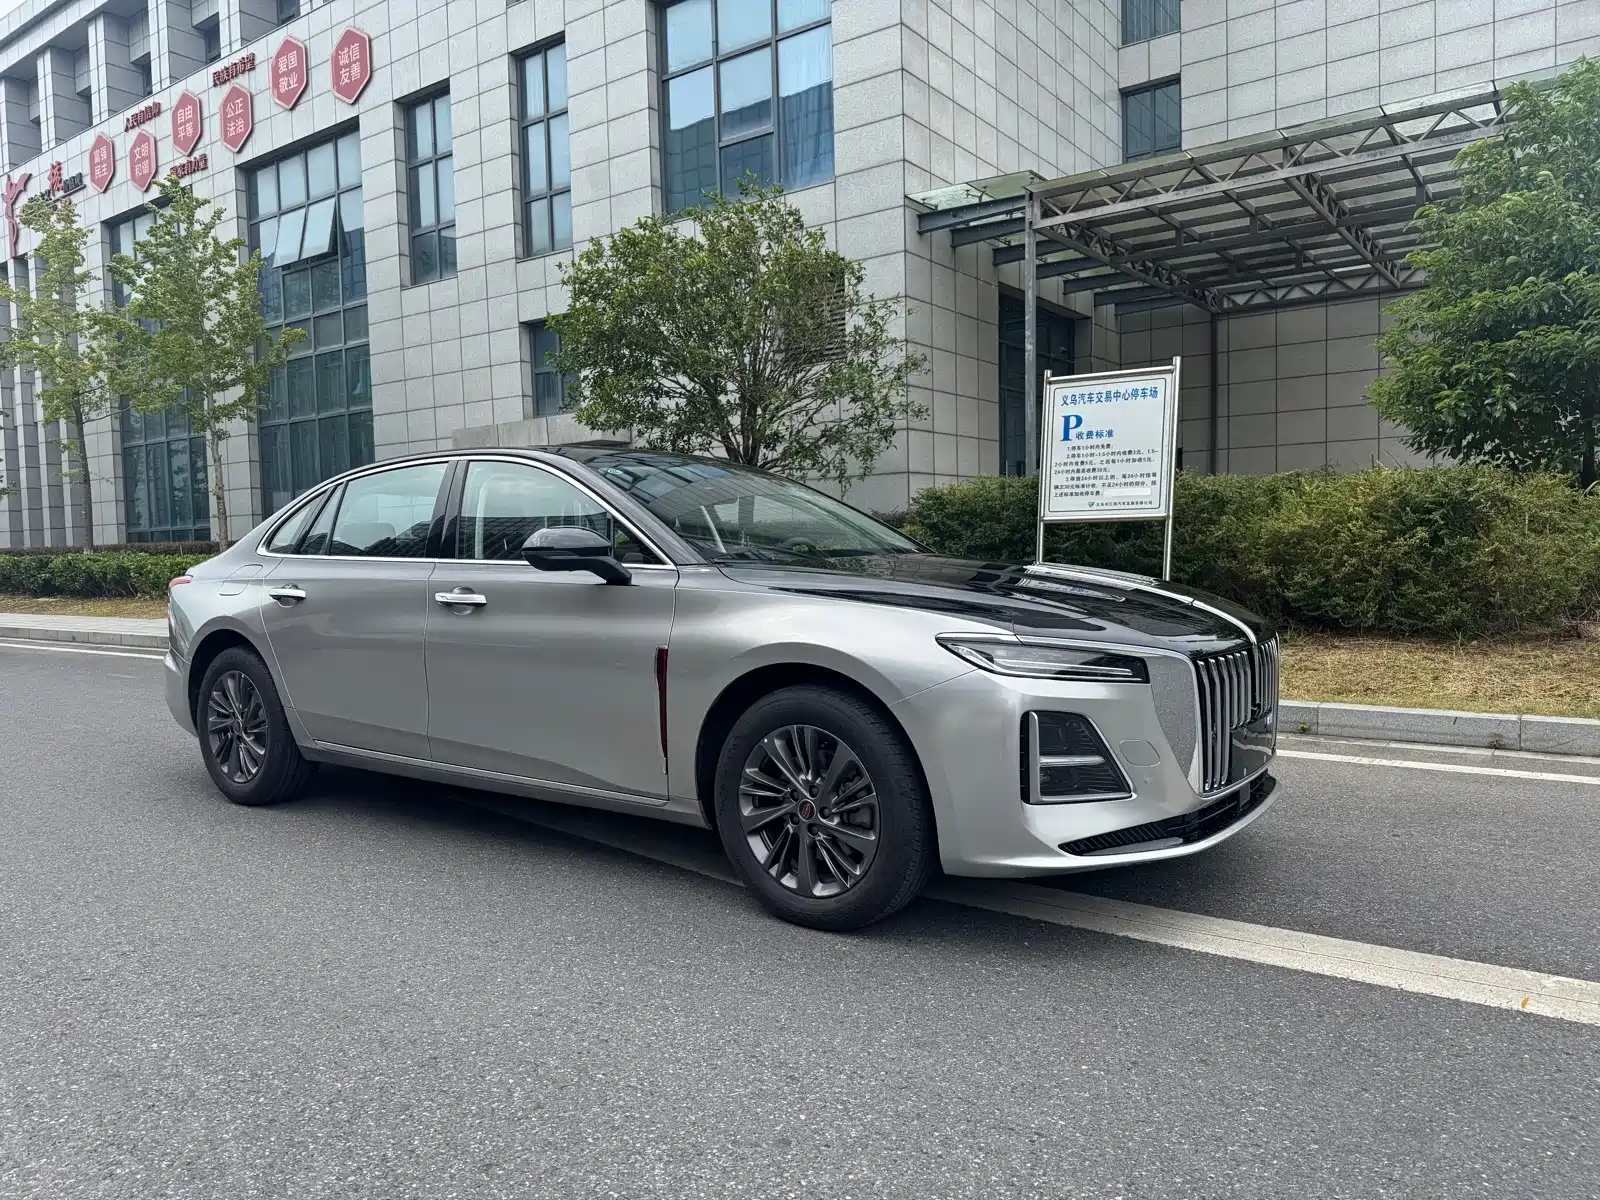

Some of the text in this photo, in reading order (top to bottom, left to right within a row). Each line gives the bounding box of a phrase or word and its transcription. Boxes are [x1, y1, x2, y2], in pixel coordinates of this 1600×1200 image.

[279, 51, 297, 74] 爱国
[339, 42, 359, 66] 诚信
[279, 72, 298, 93] 敬业
[340, 62, 360, 86] 友善
[177, 105, 192, 124] 自由
[226, 98, 243, 118] 公正
[178, 122, 193, 140] 平等
[227, 118, 244, 138] 法治
[134, 142, 148, 162] 文明
[95, 163, 108, 180] 民主
[135, 159, 149, 178] 和谐
[1060, 386, 1158, 406] 义乌汽车交易中心停车场
[1060, 414, 1083, 441] P
[1075, 429, 1114, 440] 收费标准
